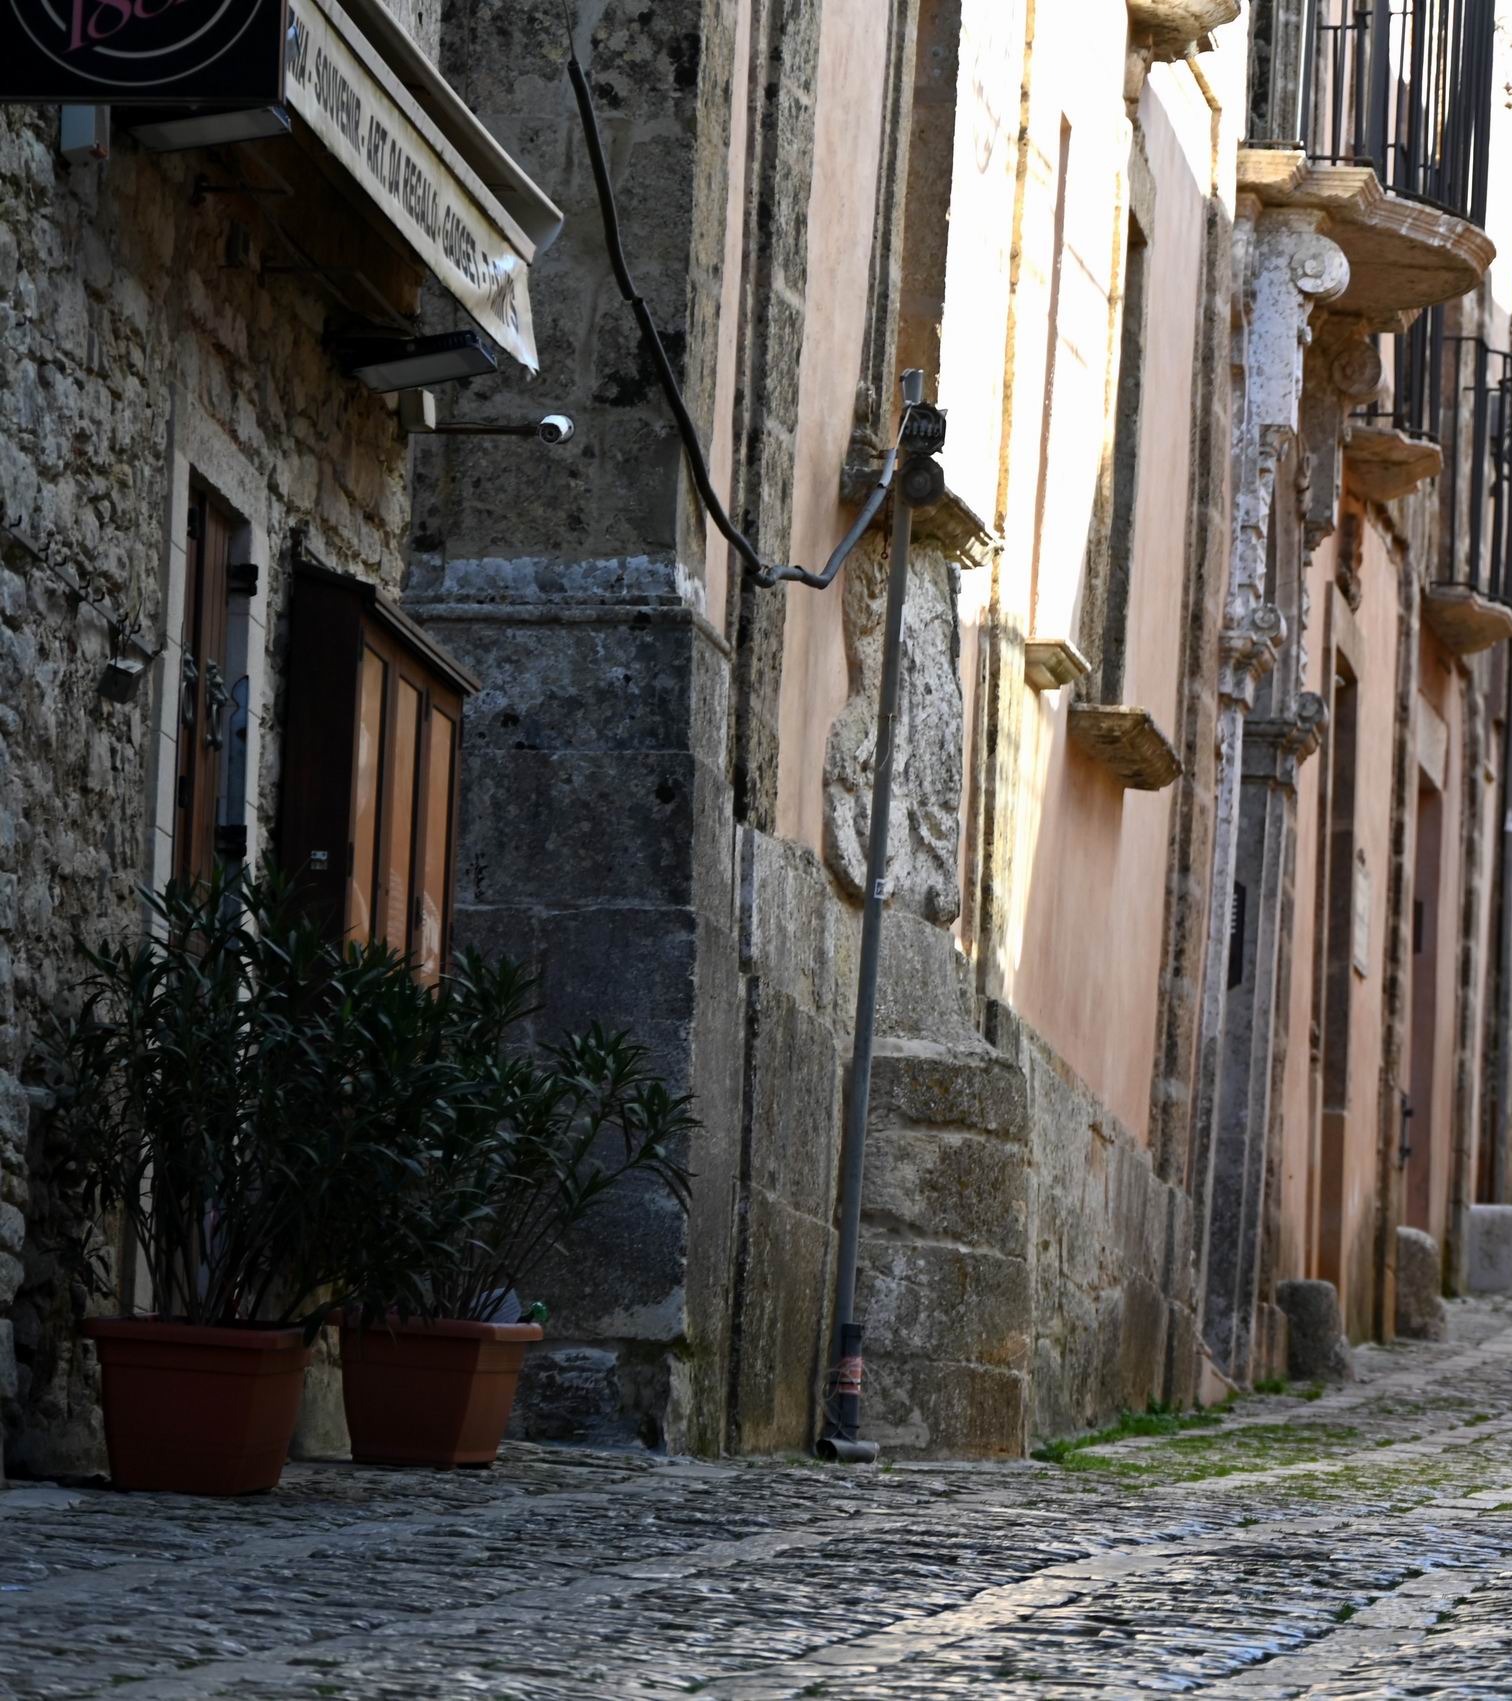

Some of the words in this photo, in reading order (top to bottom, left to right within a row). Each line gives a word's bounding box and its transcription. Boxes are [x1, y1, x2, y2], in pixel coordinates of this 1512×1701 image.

[314, 47, 361, 156] SOUVENIR
[366, 114, 388, 189] ART.
[388, 138, 402, 204] DA
[402, 154, 438, 245] REGALO
[442, 205, 480, 290] GADGET
[481, 250, 520, 335] T-STS
